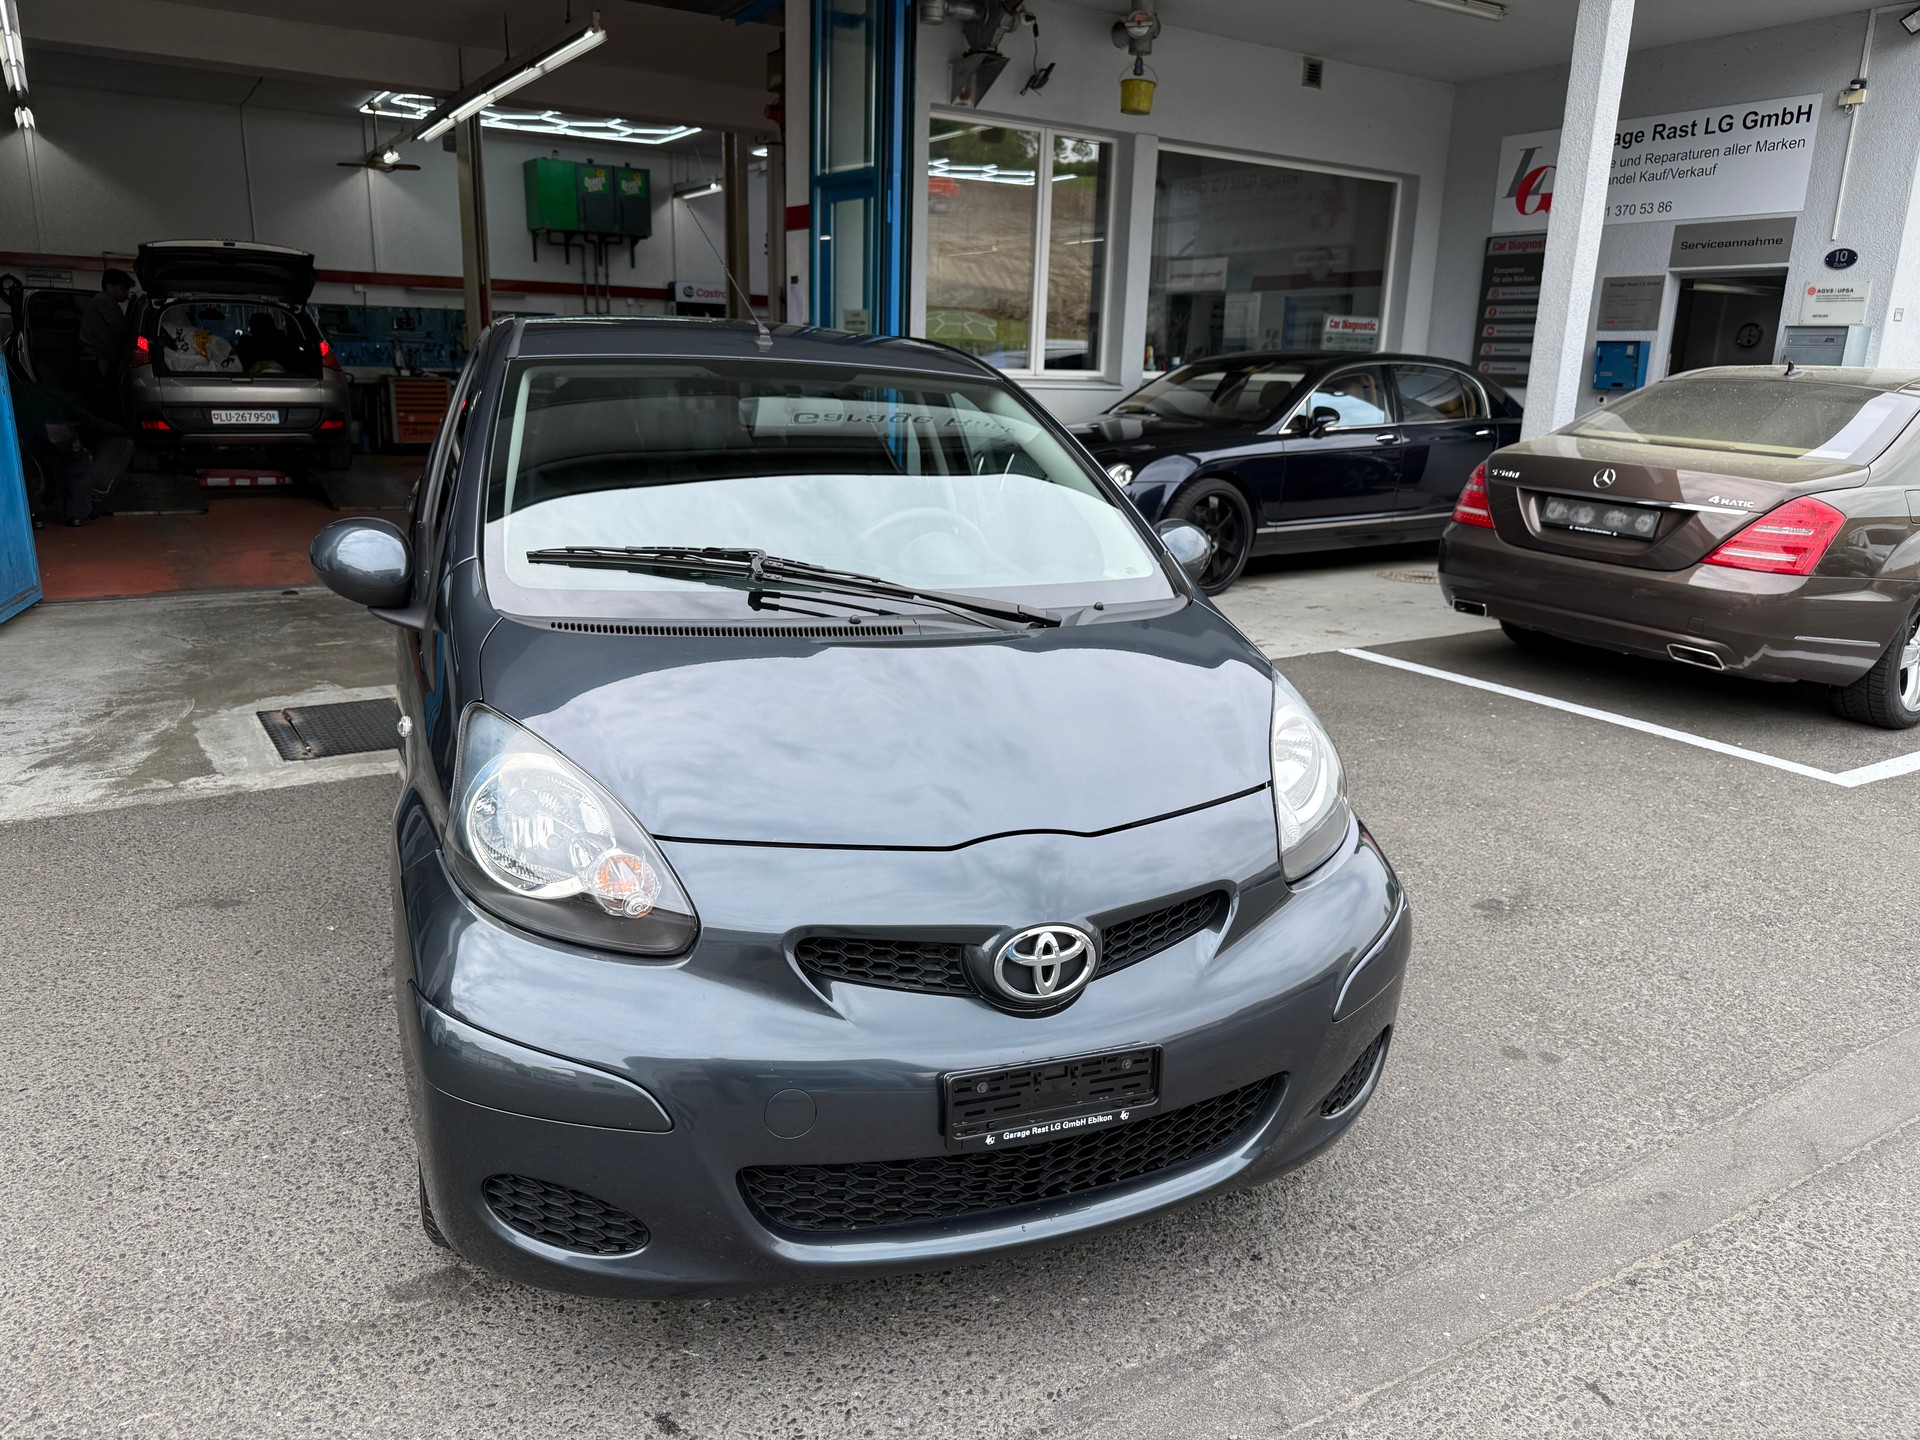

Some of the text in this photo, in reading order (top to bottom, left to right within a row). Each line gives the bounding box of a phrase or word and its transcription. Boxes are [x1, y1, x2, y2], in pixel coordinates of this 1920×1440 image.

[1614, 103, 1814, 149] age Rast LG GmbH
[1619, 154, 1642, 168] und
[1644, 146, 1720, 167] Reparaturen
[1723, 141, 1753, 157] aller
[1755, 136, 1806, 153] Marken
[1609, 163, 1718, 186] ndel Kauf/Verkauf
[1614, 202, 1637, 217] 370
[1639, 201, 1655, 216] 53
[1656, 200, 1673, 214] 86
[1679, 235, 1784, 251] Serviceannahme
[1834, 250, 1849, 263] 10
[696, 288, 728, 299] Castro
[1329, 319, 1377, 332] Car Diagnostic
[1003, 1128, 1030, 1141] Garage
[1032, 1125, 1049, 1135] Rast
[1050, 1122, 1061, 1132] LG
[1062, 1118, 1087, 1130] GmbH
[1088, 1113, 1113, 1125] Ebikon
